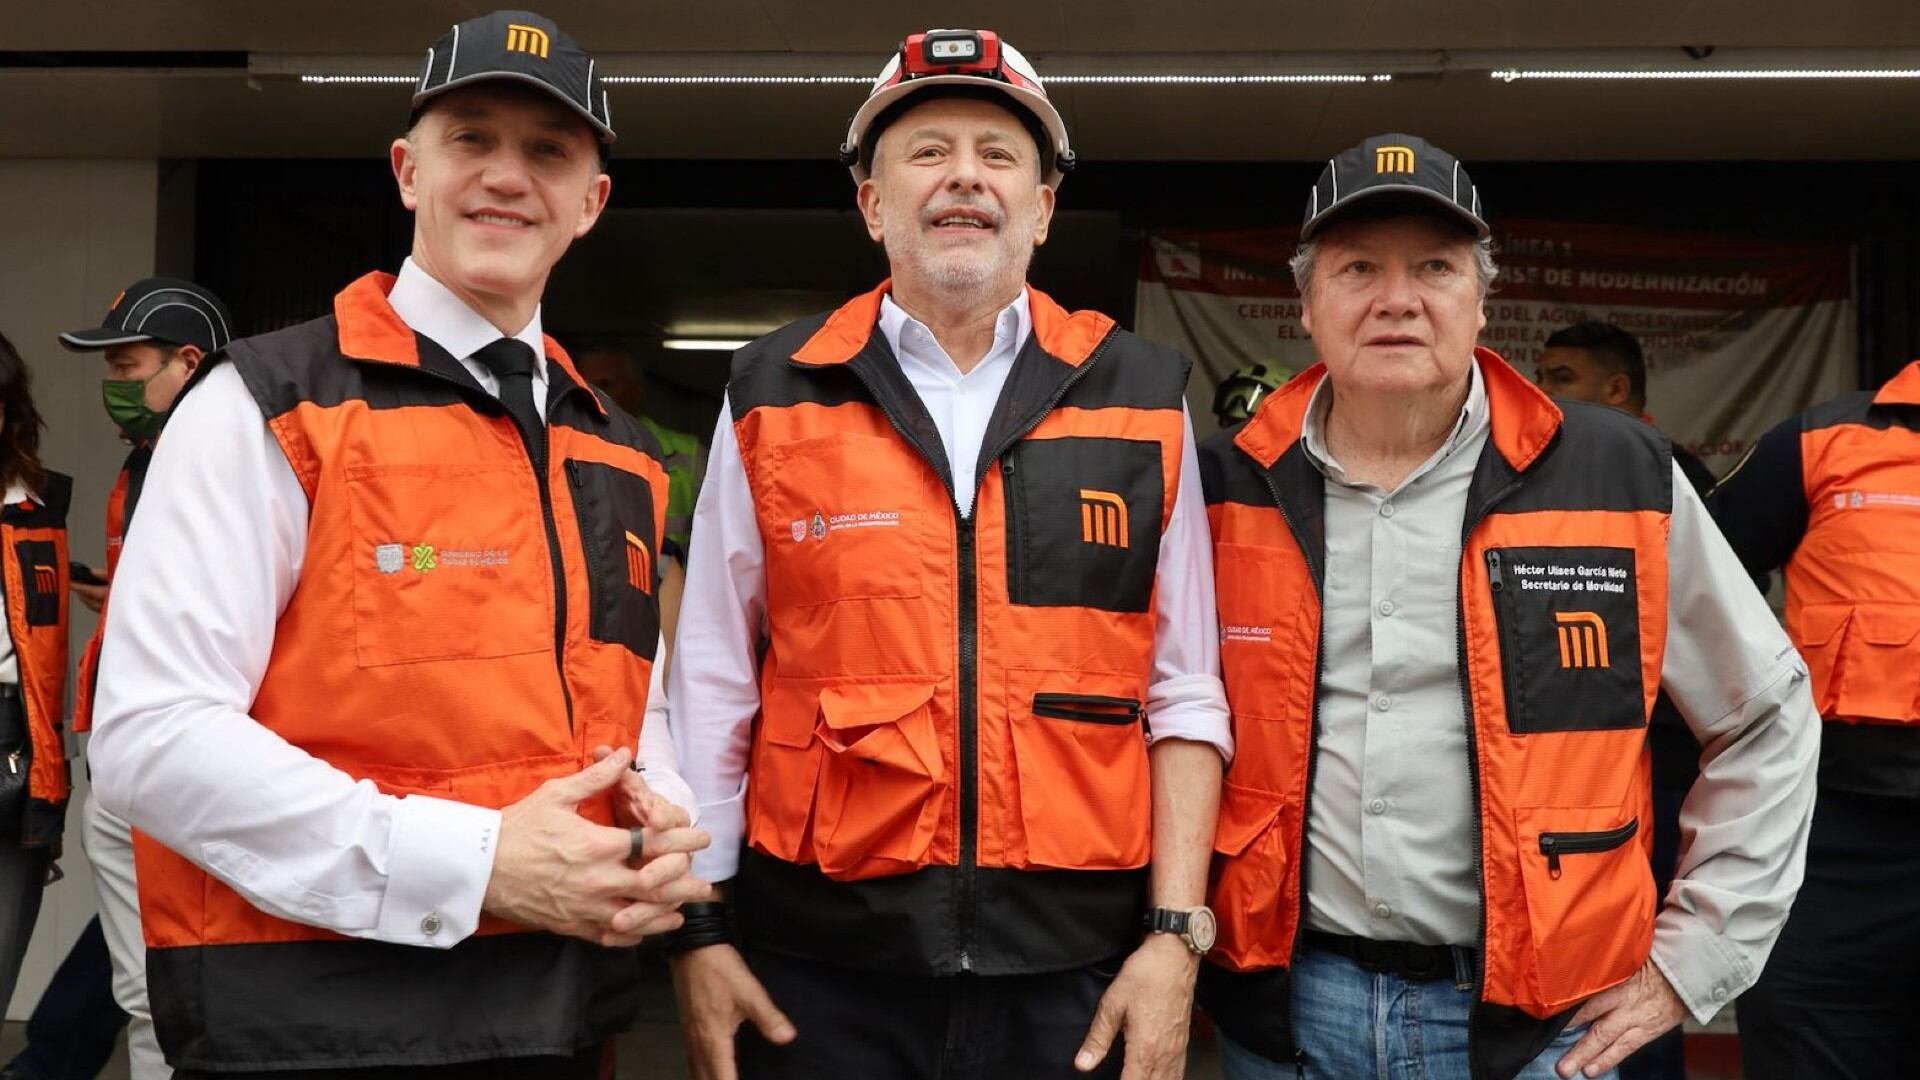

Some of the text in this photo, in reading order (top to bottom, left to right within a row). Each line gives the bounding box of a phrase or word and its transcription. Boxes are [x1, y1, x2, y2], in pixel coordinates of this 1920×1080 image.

[1544, 268, 1573, 287] DE
[1579, 270, 1768, 296] MODERNIZACIÓN
[1238, 304, 1303, 320] CERRA
[1501, 306, 1533, 322] DEL
[1278, 324, 1297, 340] EL
[1513, 563, 1546, 576] Héctor
[1547, 564, 1576, 576] Ulises
[1577, 565, 1607, 578] García
[1521, 579, 1625, 594] Secretario de Movilidad
